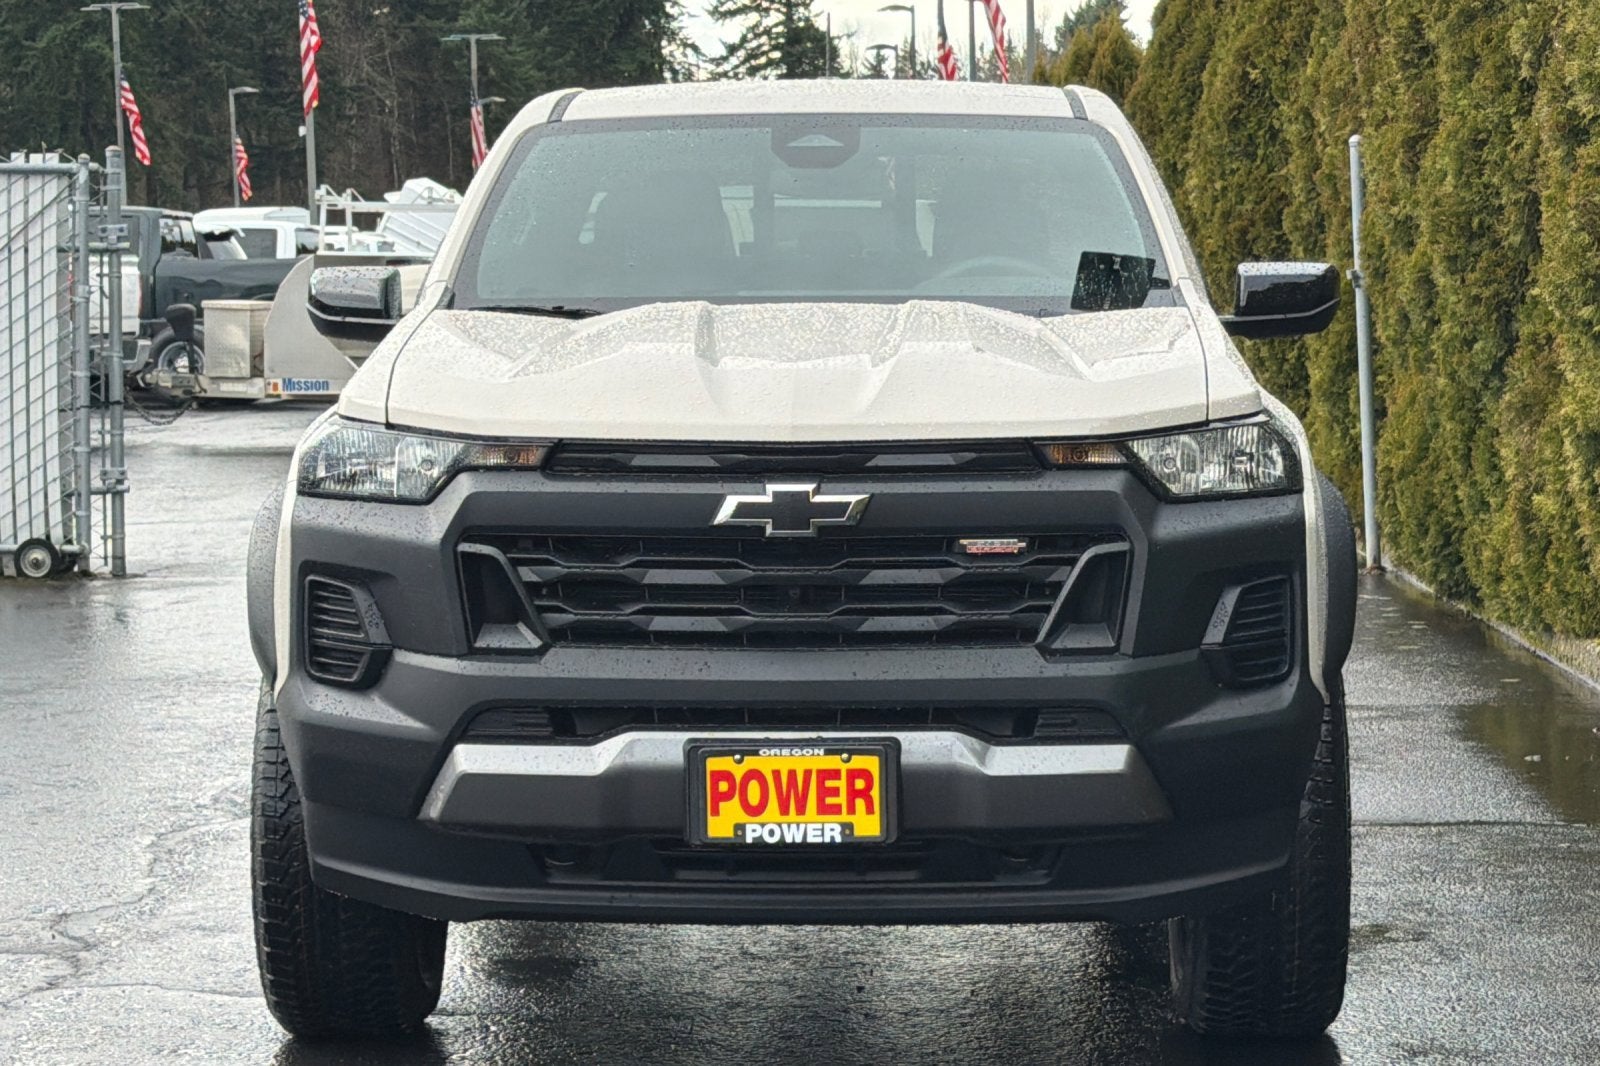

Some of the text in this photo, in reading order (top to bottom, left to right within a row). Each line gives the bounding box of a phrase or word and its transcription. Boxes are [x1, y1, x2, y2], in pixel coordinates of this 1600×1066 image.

[759, 748, 824, 757] OREGON
[709, 768, 875, 817] POWER
[745, 823, 842, 843] POWER
